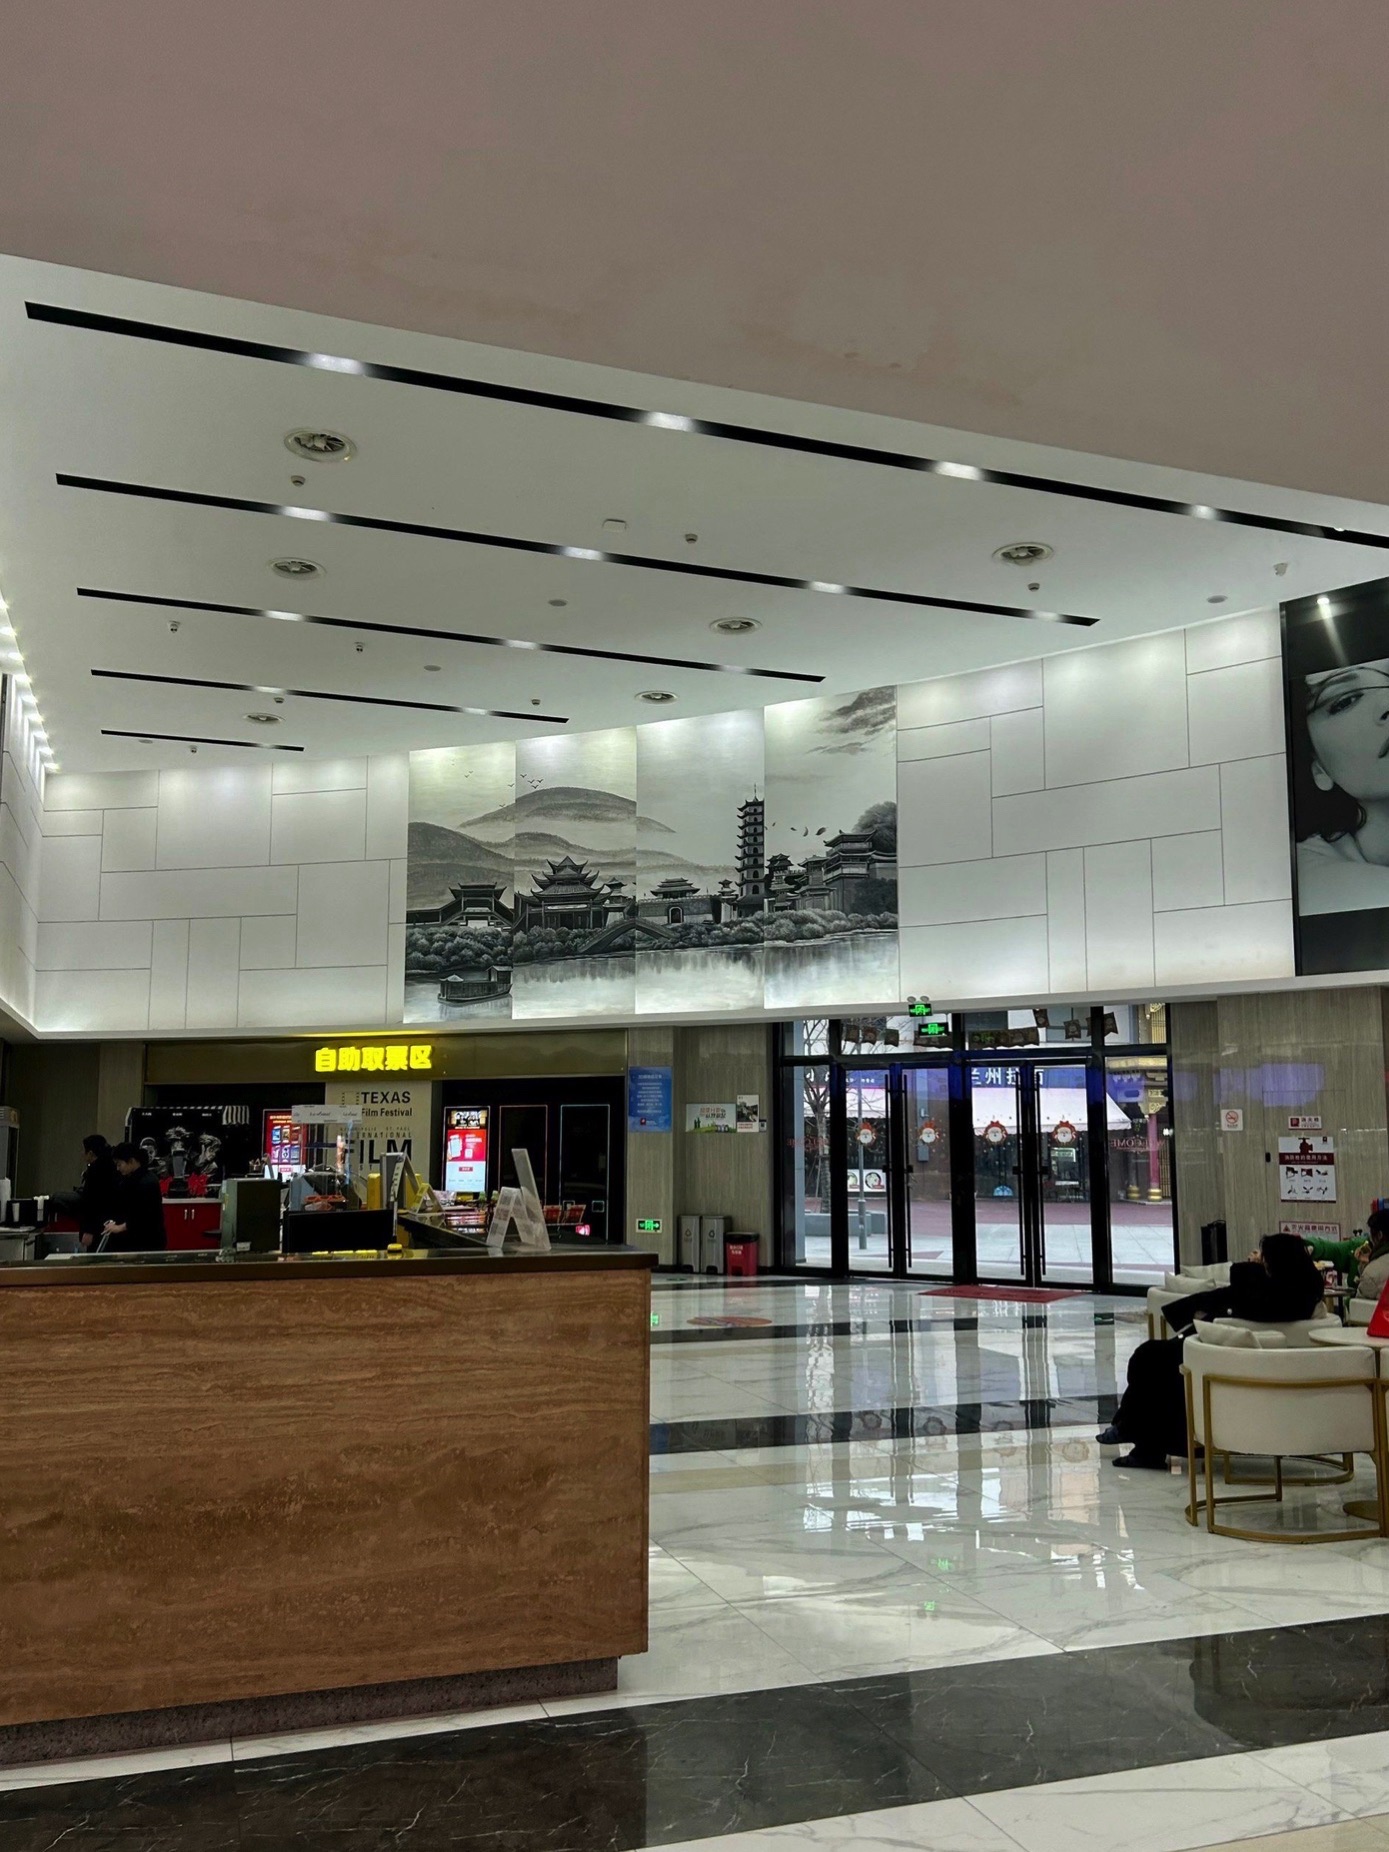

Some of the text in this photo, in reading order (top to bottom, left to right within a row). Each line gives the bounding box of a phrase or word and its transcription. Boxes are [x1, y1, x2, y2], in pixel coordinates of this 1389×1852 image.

[315, 1045, 432, 1072] 自助取票区
[361, 1091, 411, 1104] TEXAS
[361, 1107, 379, 1117] Film
[380, 1107, 413, 1117] Festival
